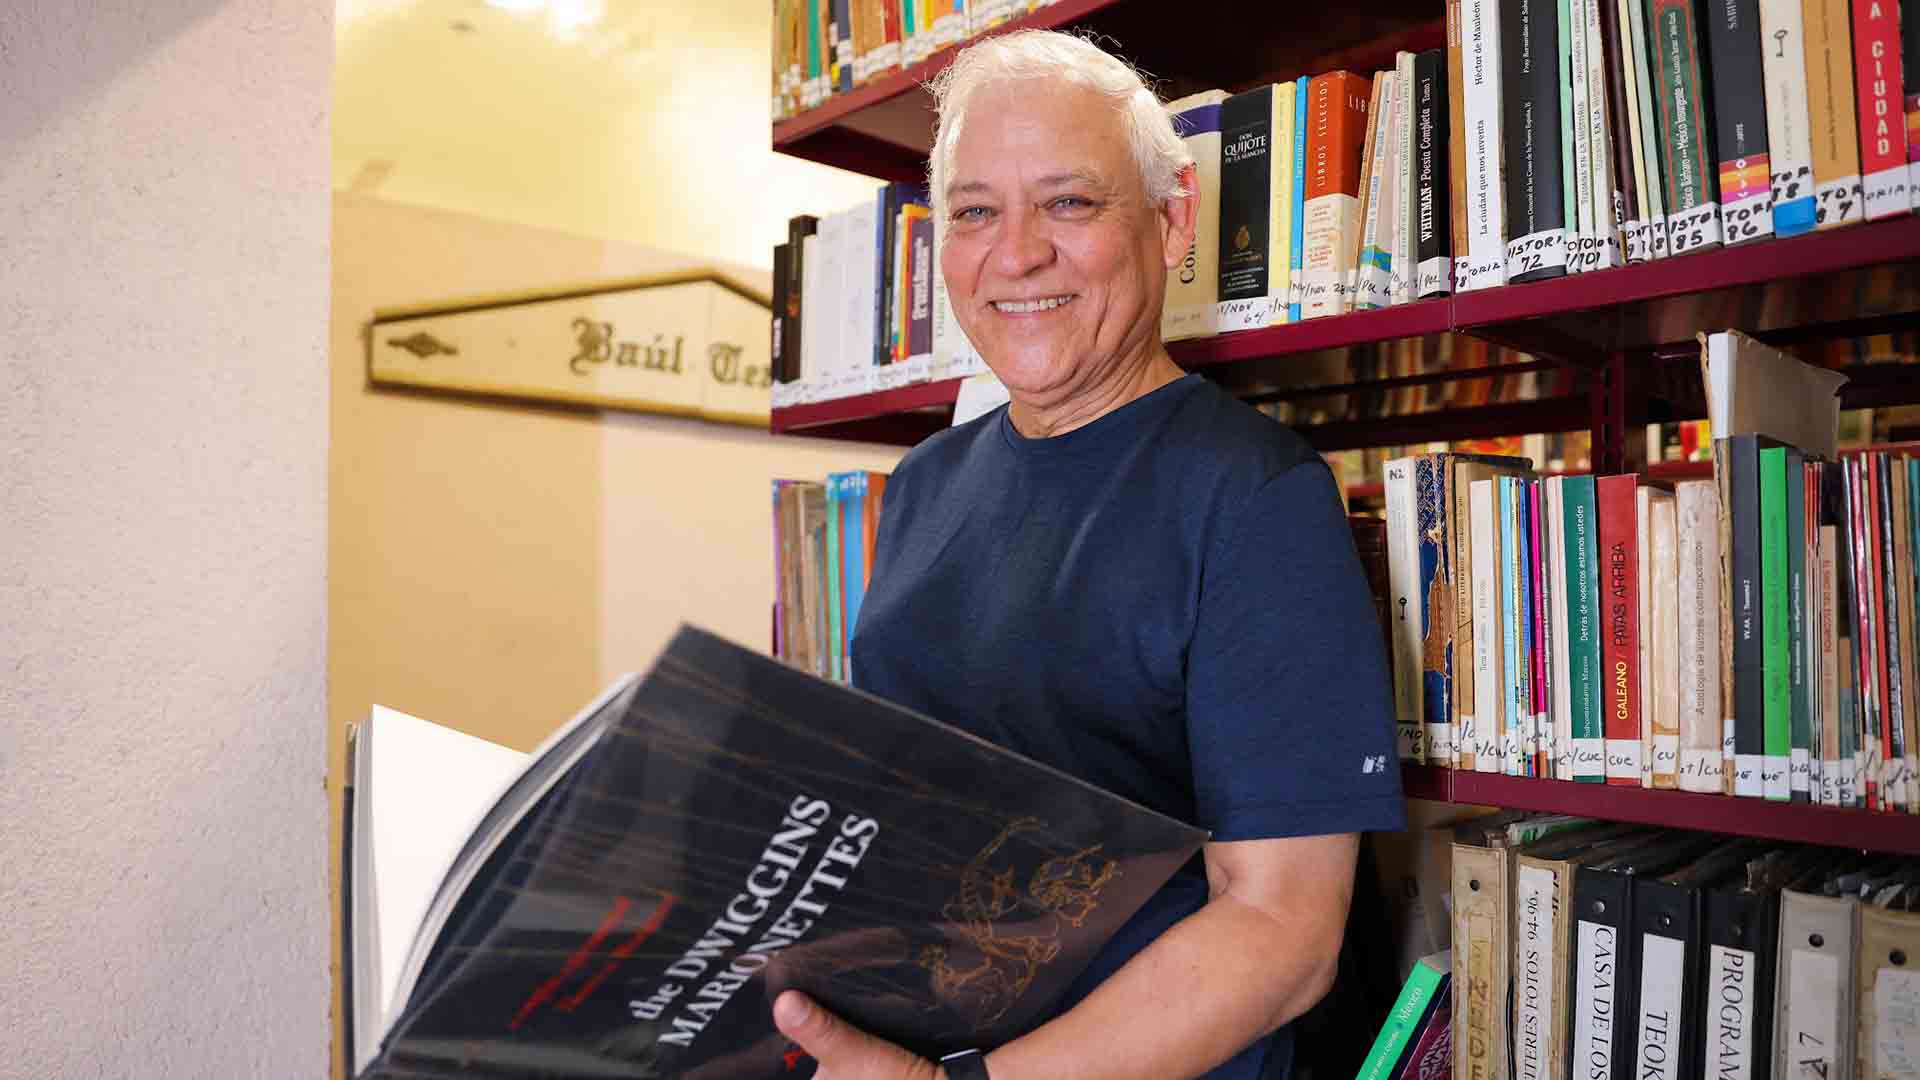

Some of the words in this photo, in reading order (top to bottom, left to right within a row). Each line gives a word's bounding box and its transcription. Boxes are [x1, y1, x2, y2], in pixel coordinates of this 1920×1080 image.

[1473, 42, 1482, 54] de
[1474, 55, 1483, 86] Héctor
[1319, 80, 1330, 137] SELECTOS
[1872, 41, 1890, 156] CIUDAD
[1420, 109, 1432, 149] Completa
[1592, 110, 1600, 121] LA
[1592, 122, 1601, 135] EN
[1224, 135, 1267, 156] QUIJOTE
[1317, 144, 1328, 187] LIBROS
[1480, 174, 1488, 191] que
[1421, 186, 1433, 243] WHITMAN
[1478, 193, 1487, 222] ciudad
[1480, 223, 1487, 235] La
[1675, 231, 1704, 250] 85
[1728, 223, 1759, 240] 86
[1521, 254, 1543, 273] 72
[569, 317, 684, 376] Baúl
[1576, 505, 1584, 535] ustedes
[1578, 536, 1586, 568] estamos
[1579, 569, 1587, 602] nosotros
[1611, 541, 1626, 599] ARRIBA
[1580, 603, 1587, 614] de
[1613, 603, 1626, 647] PATAS
[1580, 615, 1588, 641] Detrás
[1615, 661, 1629, 721] GALEANO
[628, 982, 684, 1022] the
[674, 793, 833, 980] DWIGGINS
[657, 812, 880, 1048] MARIONETTES
[1593, 927, 1614, 990] CASA
[1526, 950, 1539, 1010] FOTOS
[1592, 997, 1611, 1031] DE
[1591, 1036, 1609, 1080] LOS
